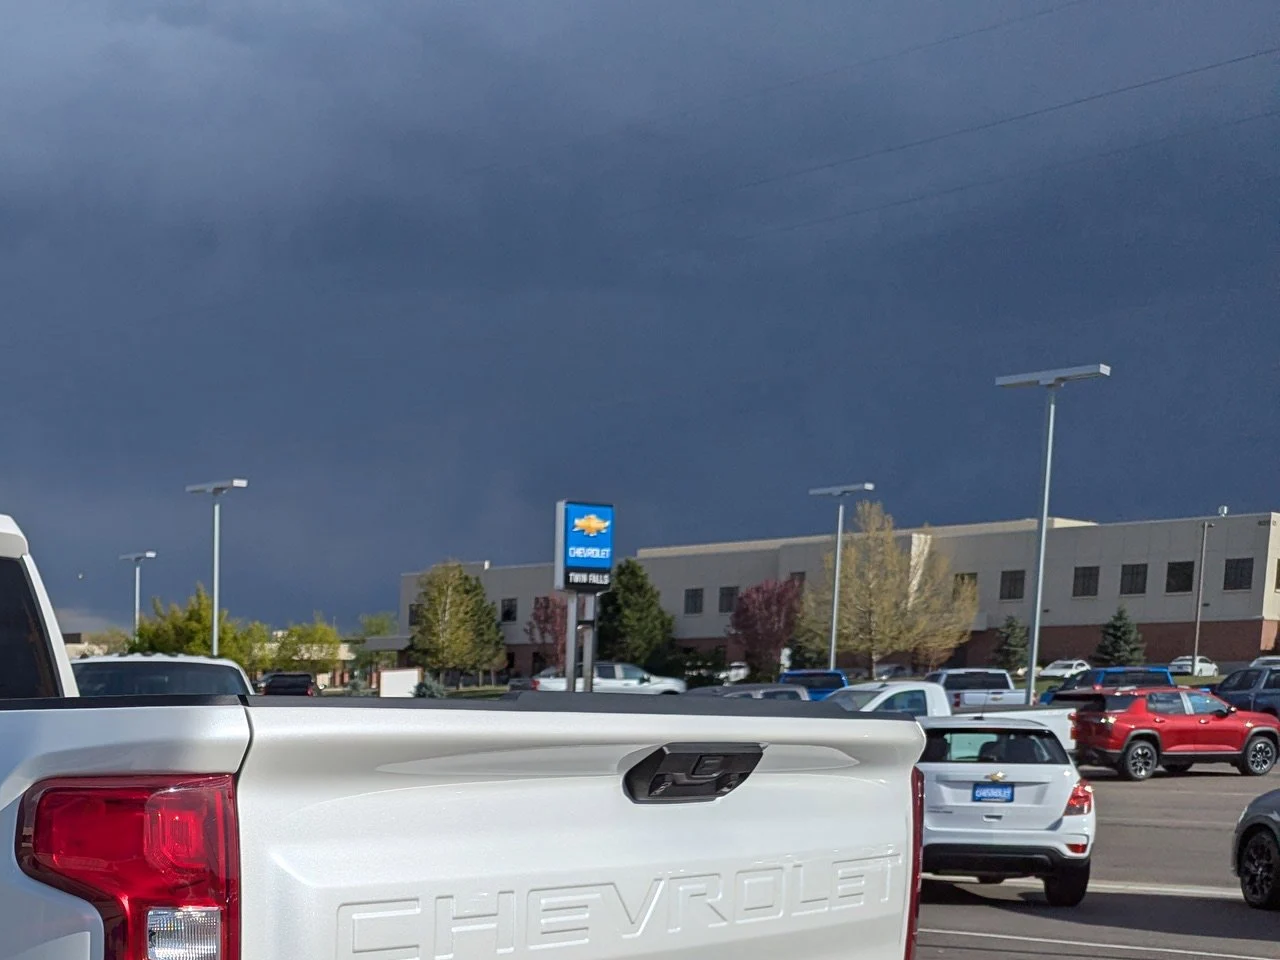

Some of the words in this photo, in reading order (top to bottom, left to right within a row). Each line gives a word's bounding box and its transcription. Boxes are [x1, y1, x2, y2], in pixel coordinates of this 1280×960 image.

[568, 547, 611, 559] CHEVROLET
[568, 572, 587, 584] TWIN
[588, 573, 610, 585] FALLS
